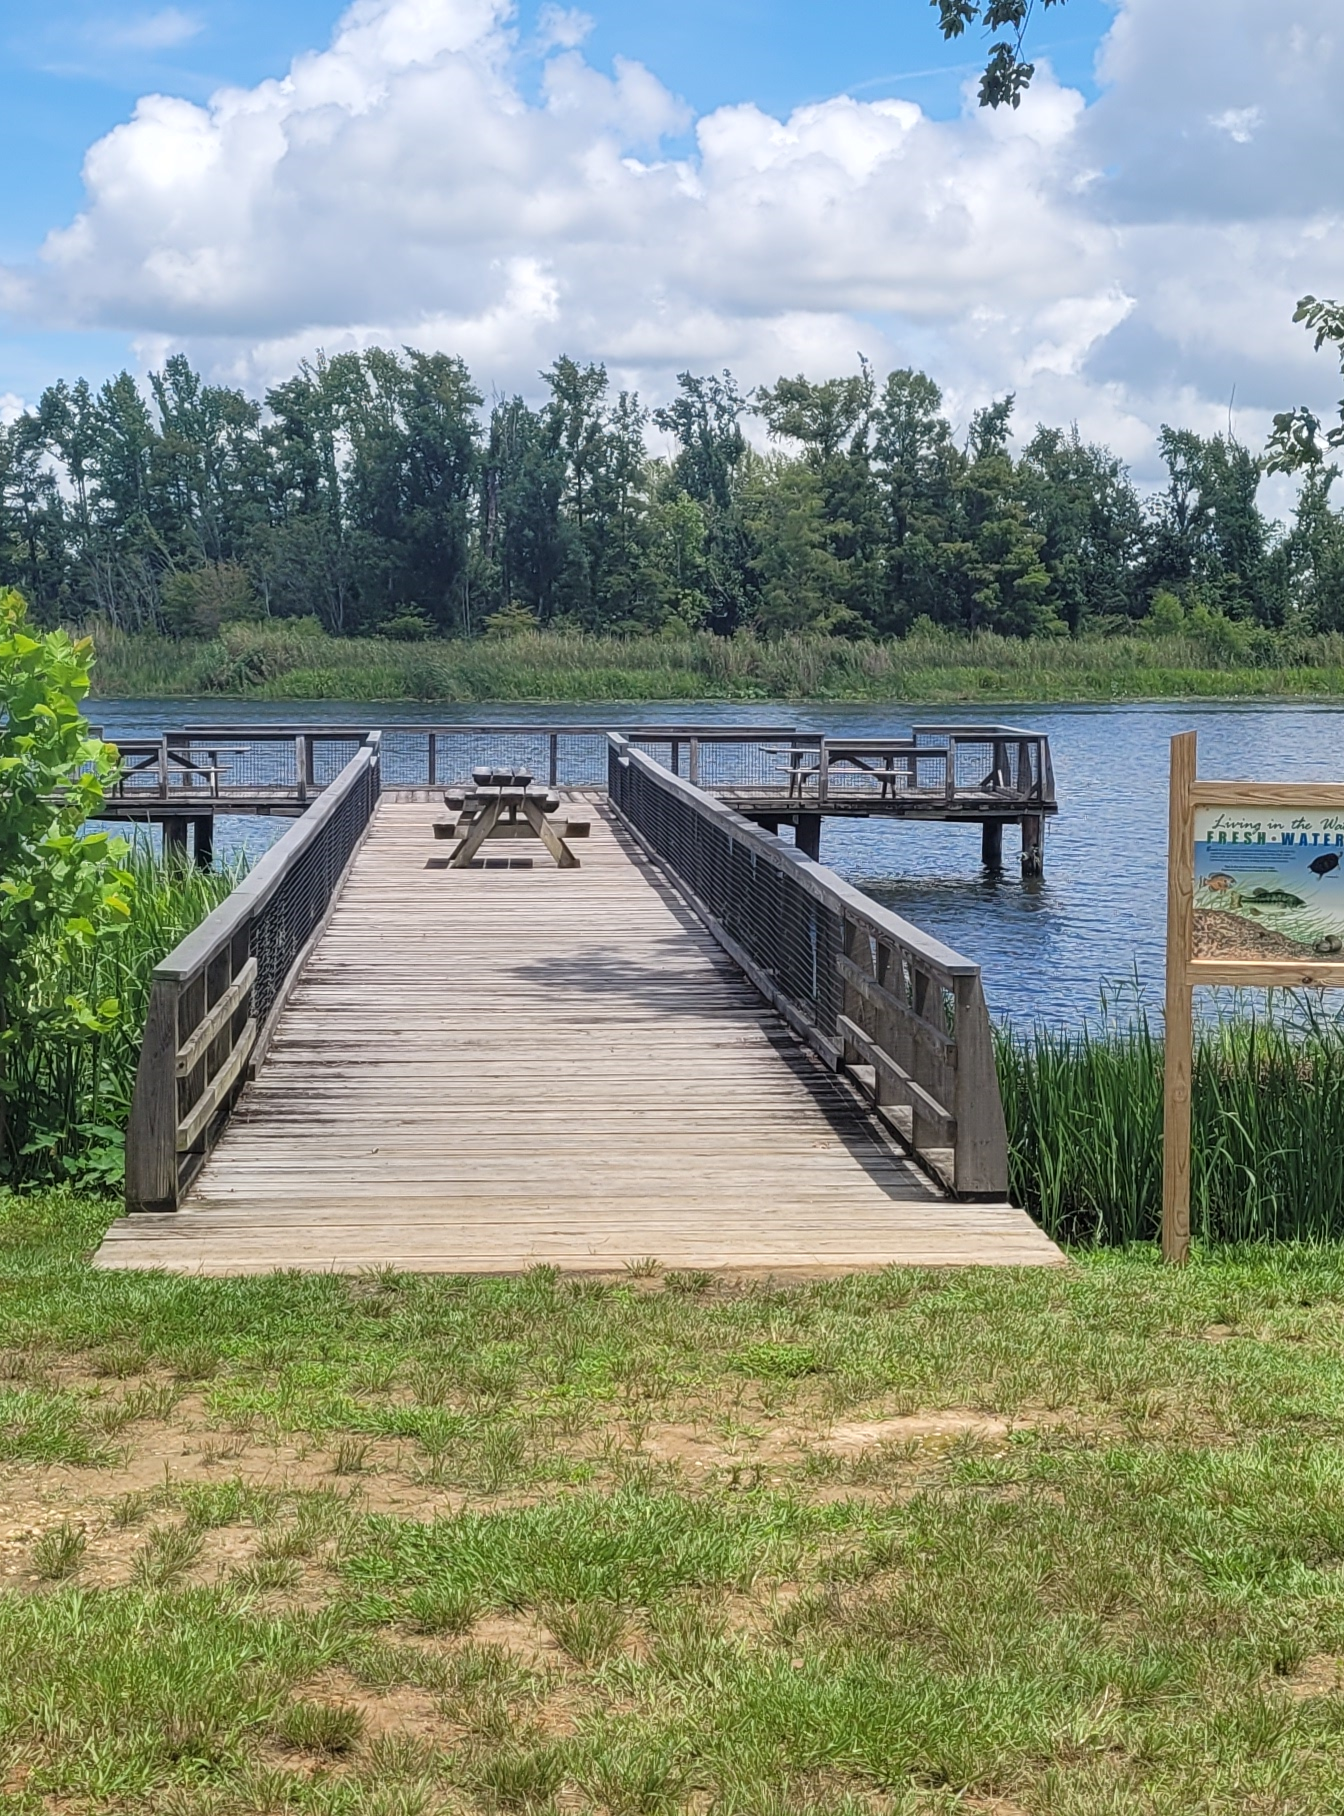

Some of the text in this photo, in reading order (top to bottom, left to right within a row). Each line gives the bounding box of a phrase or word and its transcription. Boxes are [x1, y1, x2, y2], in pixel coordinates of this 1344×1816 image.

[1212, 814, 1261, 835] Living
[1267, 819, 1284, 829] in
[1291, 817, 1312, 830] the
[1207, 831, 1344, 847] FRESH WATER
